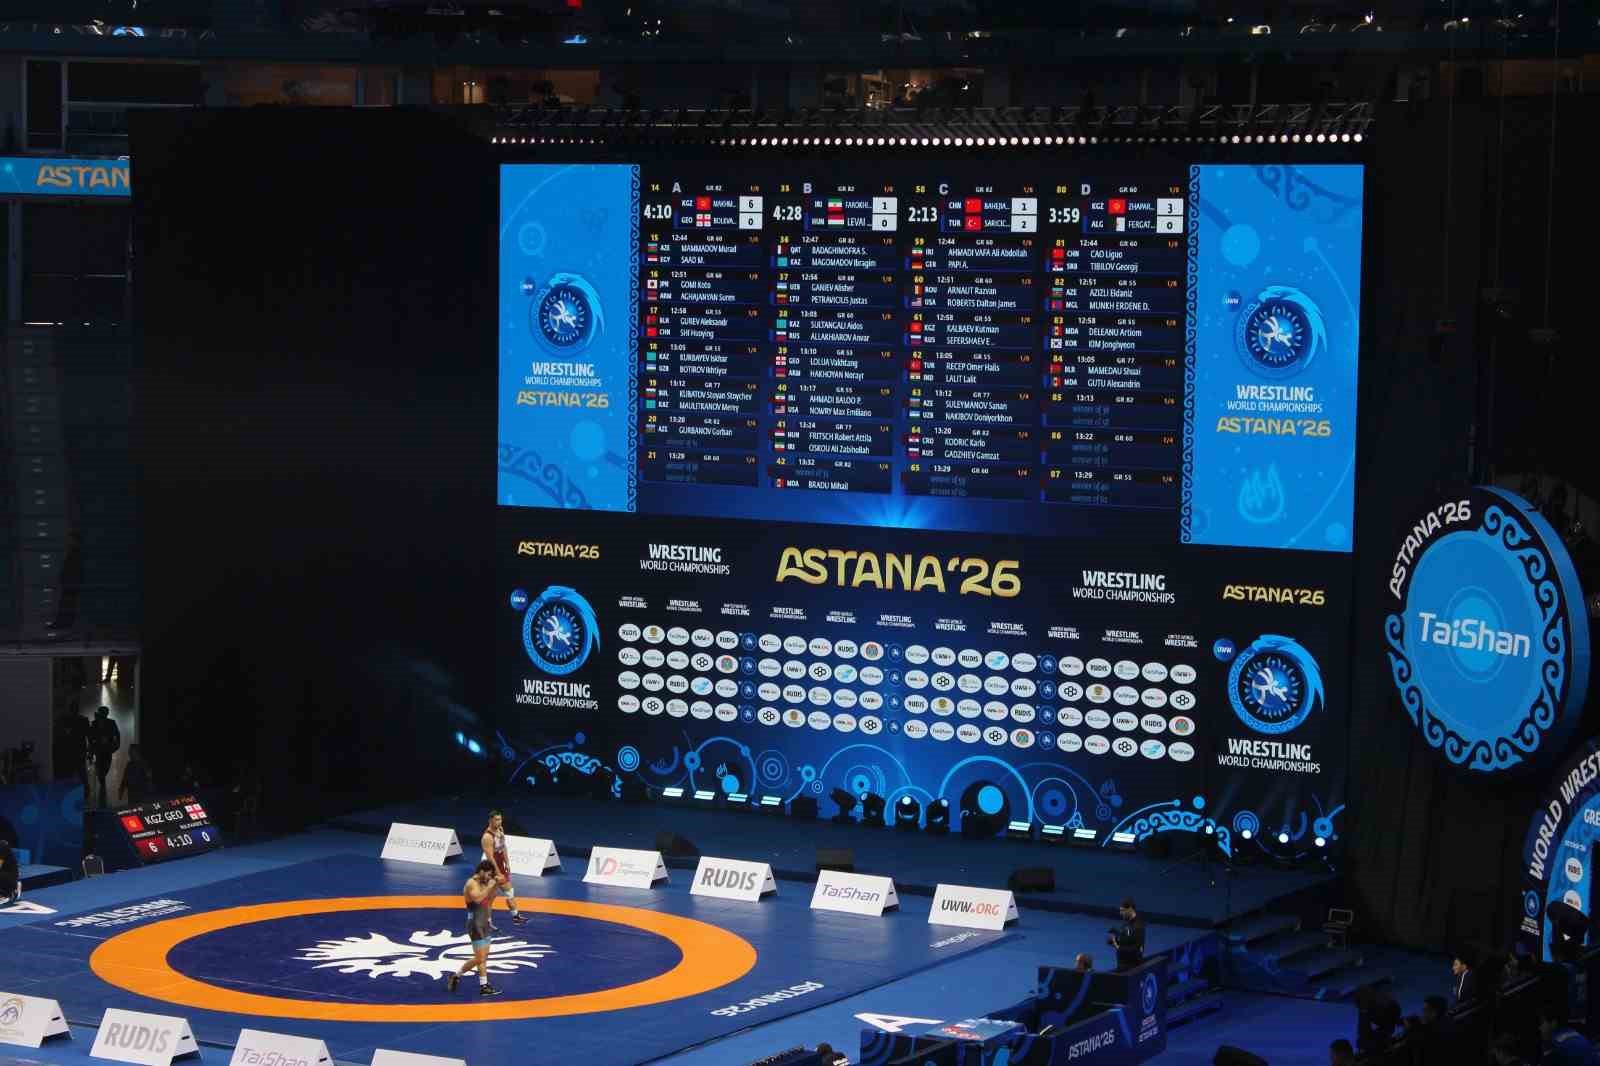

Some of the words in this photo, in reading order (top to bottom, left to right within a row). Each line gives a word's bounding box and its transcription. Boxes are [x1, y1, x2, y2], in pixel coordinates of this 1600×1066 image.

[36, 165, 129, 188] ASTAN
[672, 182, 681, 193] A
[803, 183, 812, 193] B
[939, 184, 949, 195] C
[1081, 184, 1091, 195] D
[644, 204, 672, 219] 4:10
[748, 200, 754, 208] 6
[882, 202, 887, 210] 1
[1022, 203, 1027, 211] 1
[1167, 204, 1173, 213] 3
[773, 206, 802, 220] 4:28
[908, 207, 938, 222] 2:13
[1049, 208, 1080, 223] 3:59
[748, 218, 753, 226] 0
[882, 219, 887, 227] 0
[1167, 222, 1172, 230] 0
[1090, 250, 1104, 258] CAO
[948, 299, 975, 307] ROBERTS
[1089, 328, 1118, 336] DELEANU
[532, 362, 594, 376] WRESTLING
[525, 376, 549, 385] WORLD
[550, 377, 602, 387] CHAMPIONSHIPS
[1236, 384, 1314, 401] WRESTLING
[1227, 400, 1256, 410] WORLD
[1258, 401, 1322, 413] CHAMPIONSHIPS
[649, 544, 721, 562] WRESTLING
[640, 560, 668, 571] WORLD
[669, 562, 730, 575] CHAMPIONSHIPS
[1082, 570, 1165, 591] WRESTLING
[1072, 587, 1104, 600] WORLD
[1106, 589, 1175, 604] CHAMPIONSHIPS
[1419, 612, 1530, 658] TaiShan
[1164, 639, 1198, 648] WRESTLING
[523, 680, 590, 698] WRESTLING
[516, 694, 541, 705] WORLD
[543, 696, 598, 710] CHAMPIONSHIPS
[1228, 738, 1311, 760] WRESTLING
[1218, 755, 1250, 768] WORLD
[1252, 758, 1320, 774] CHAMPIONSHIPS
[144, 814, 164, 825] KGZ
[164, 810, 183, 821] GEO
[149, 842, 158, 852] 6
[167, 834, 192, 848] 4:10
[202, 832, 210, 842] 0
[1530, 800, 1563, 881] WORLD
[701, 867, 758, 891] RUDIS
[821, 883, 880, 904] TaiShan
[941, 899, 1001, 917] UWW.ORG
[103, 1022, 172, 1054] RUDIS
[240, 1048, 308, 1066] TaiShan
